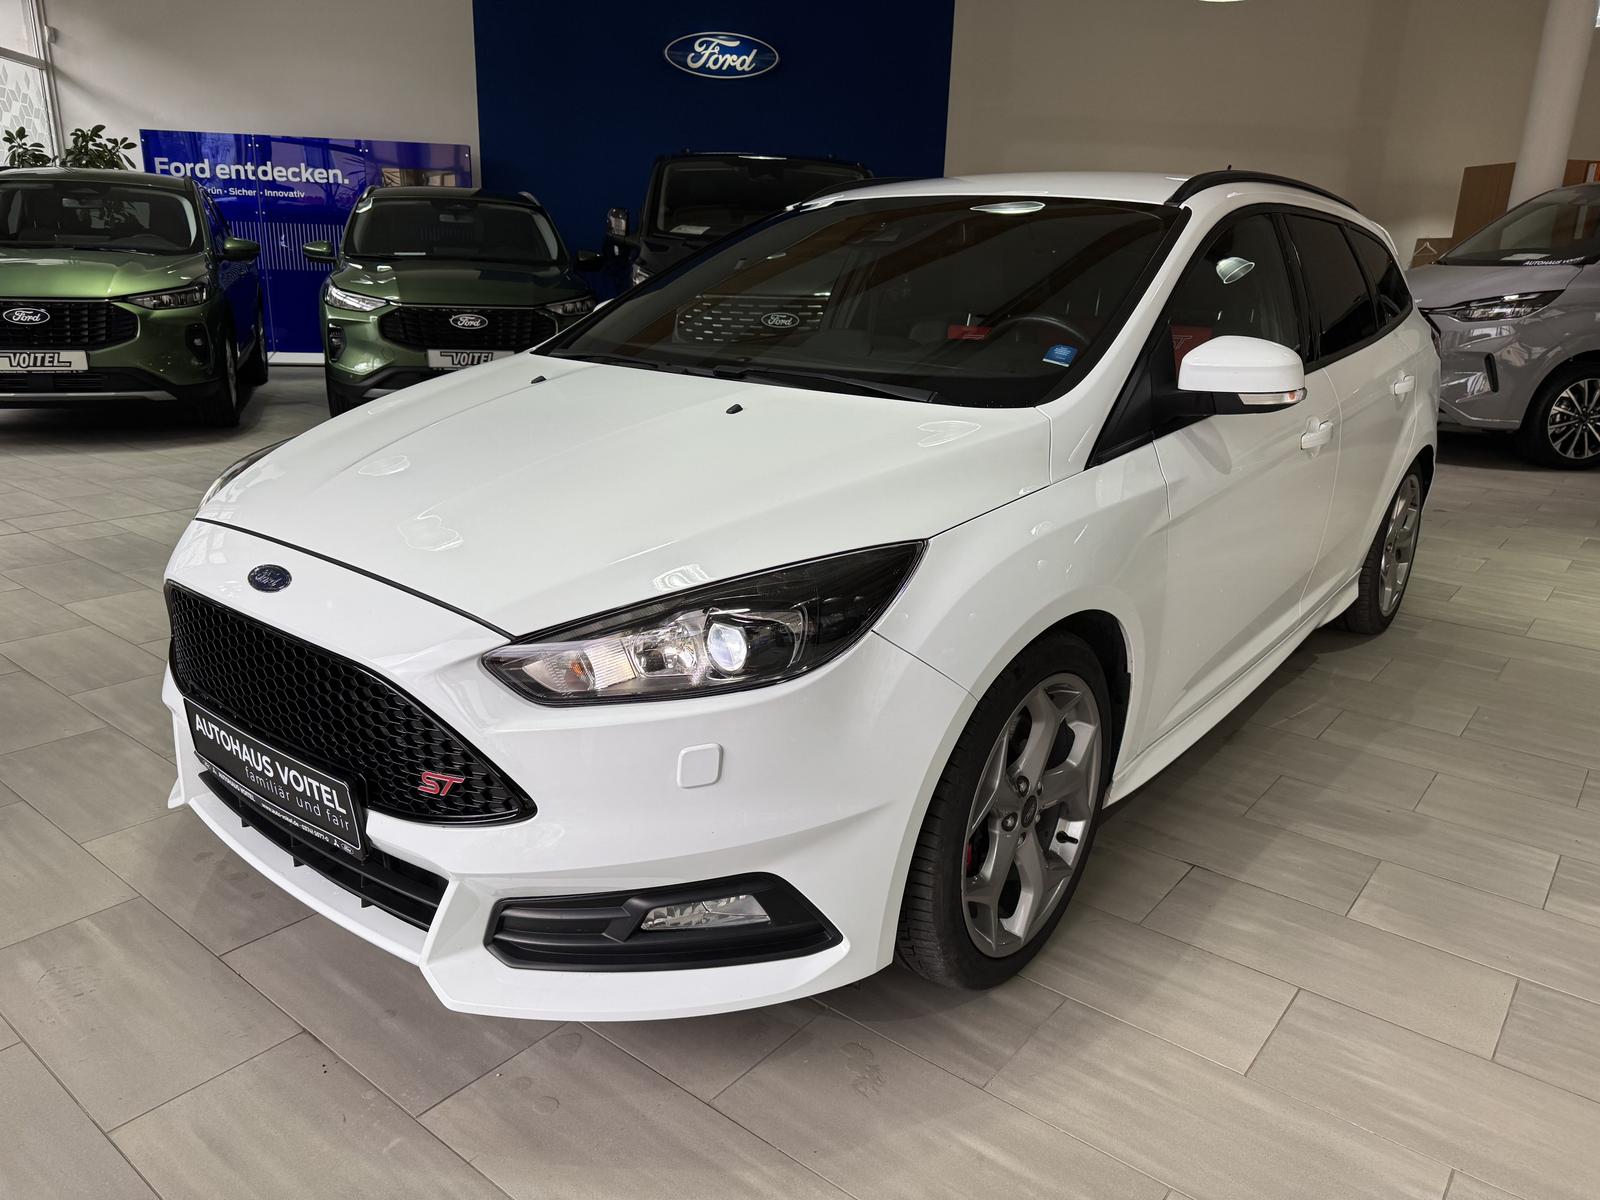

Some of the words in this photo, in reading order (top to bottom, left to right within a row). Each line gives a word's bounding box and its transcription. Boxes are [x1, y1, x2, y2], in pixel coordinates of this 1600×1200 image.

[687, 37, 757, 71] Ford
[154, 157, 210, 179] Ford
[216, 160, 350, 185] entdecken.
[229, 187, 257, 197] Sicher
[264, 189, 305, 198] Innovativ
[12, 310, 41, 321] Ford
[457, 315, 481, 327] Ford
[768, 314, 793, 325] Ford
[7, 352, 72, 368] VOITEL
[195, 713, 274, 778] AUTOHAUS
[275, 761, 347, 815] VOITEL
[418, 771, 465, 797] ST
[245, 765, 291, 801] familiär
[295, 796, 321, 817] und
[326, 808, 350, 831] fair
